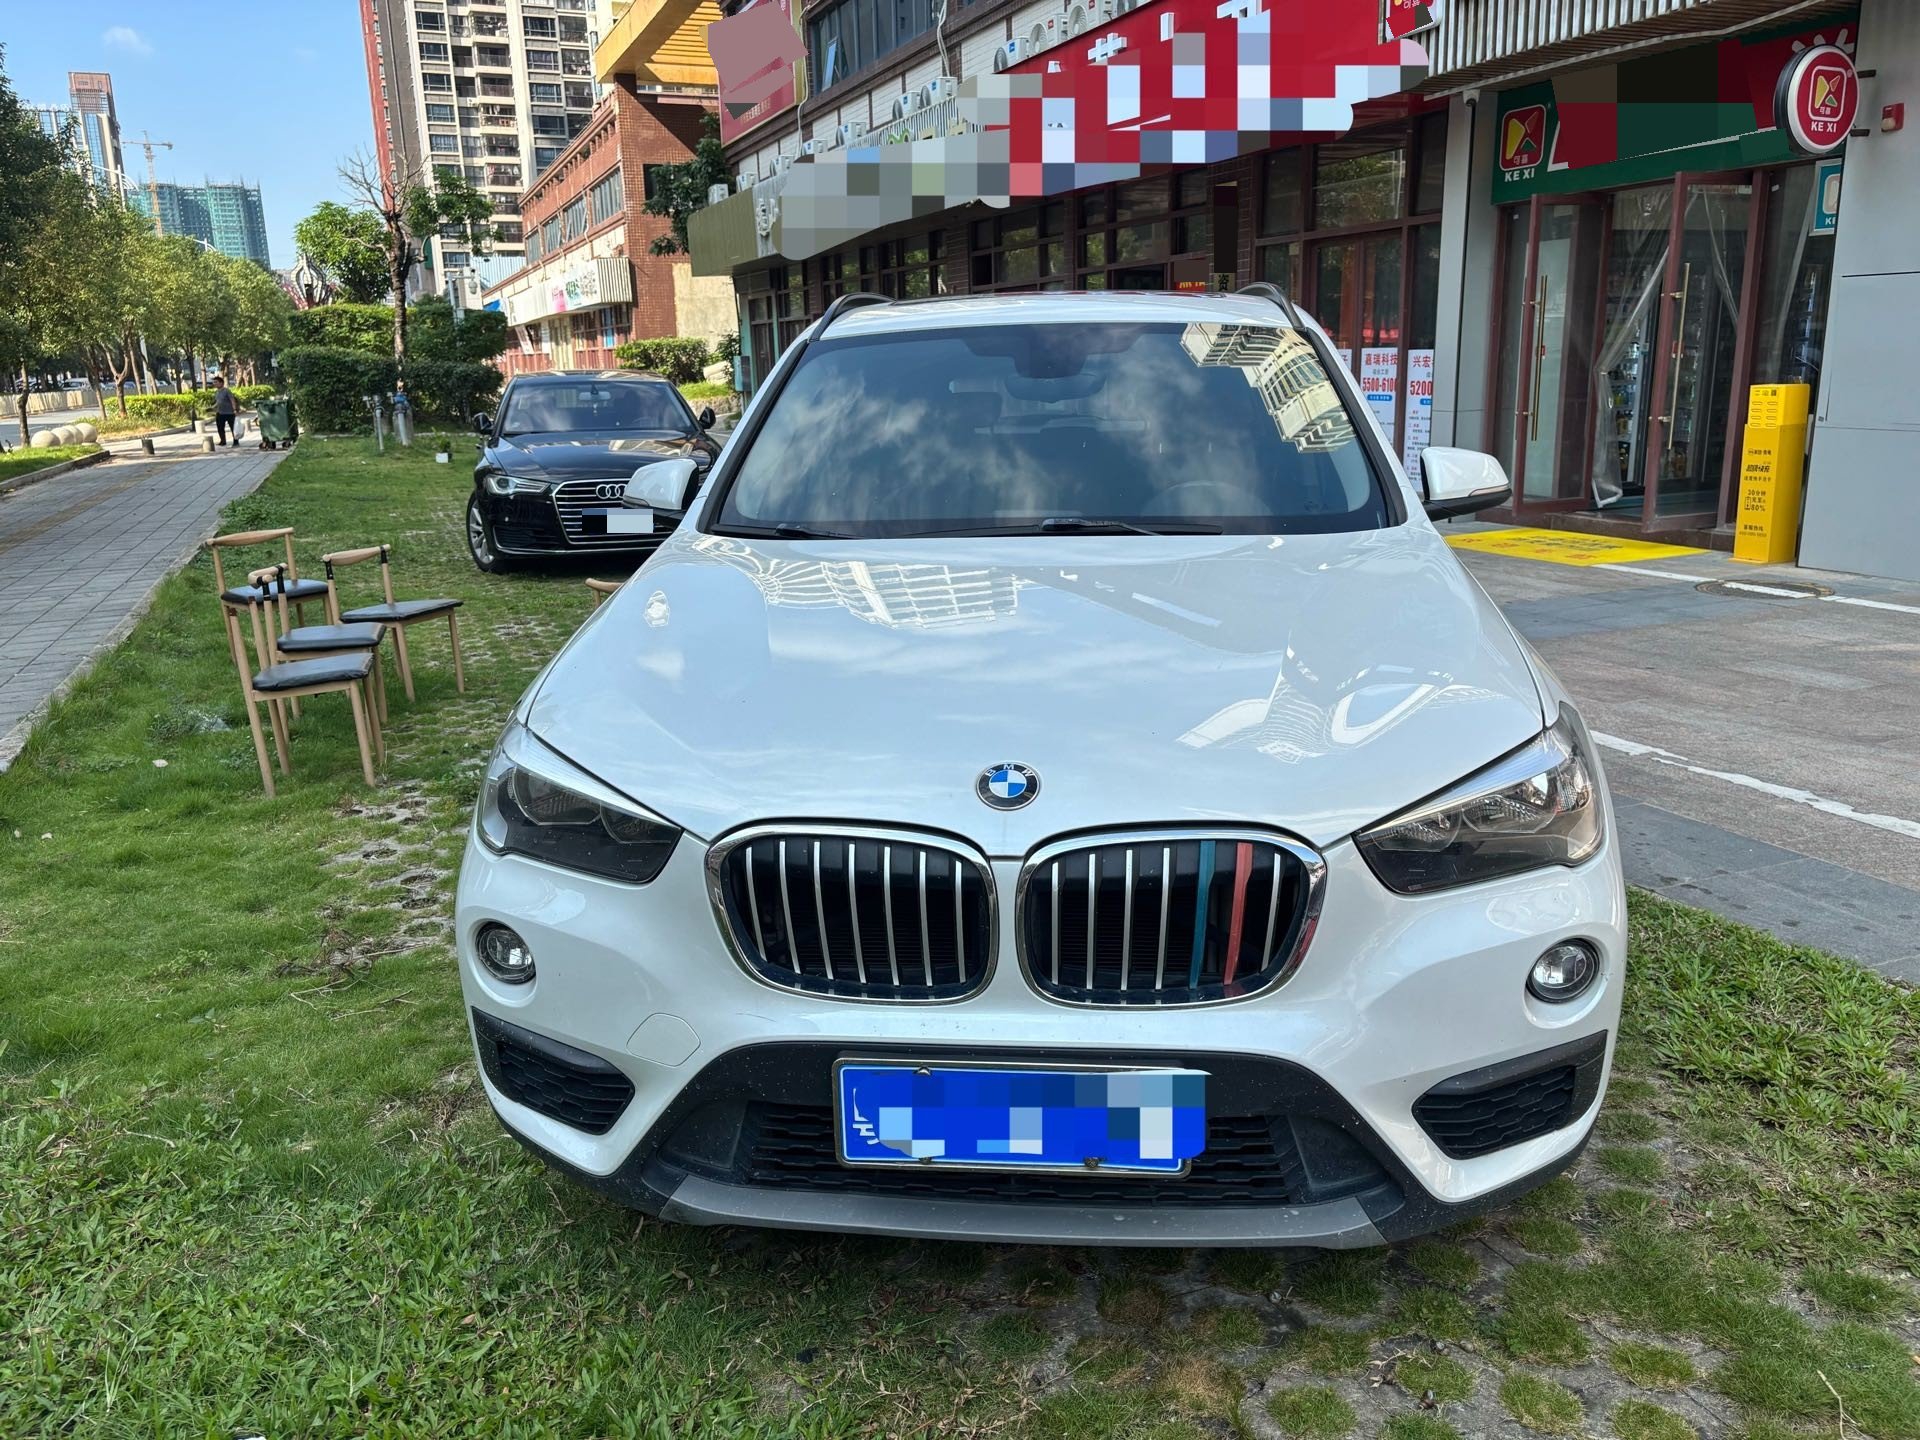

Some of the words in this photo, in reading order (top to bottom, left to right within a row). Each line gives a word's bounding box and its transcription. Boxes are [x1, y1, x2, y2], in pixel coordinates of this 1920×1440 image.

[1811, 121, 1824, 132] KE
[1826, 123, 1837, 133] XI
[1504, 170, 1521, 182] KE
[1523, 168, 1535, 179] XI
[984, 763, 1036, 777] BMW
